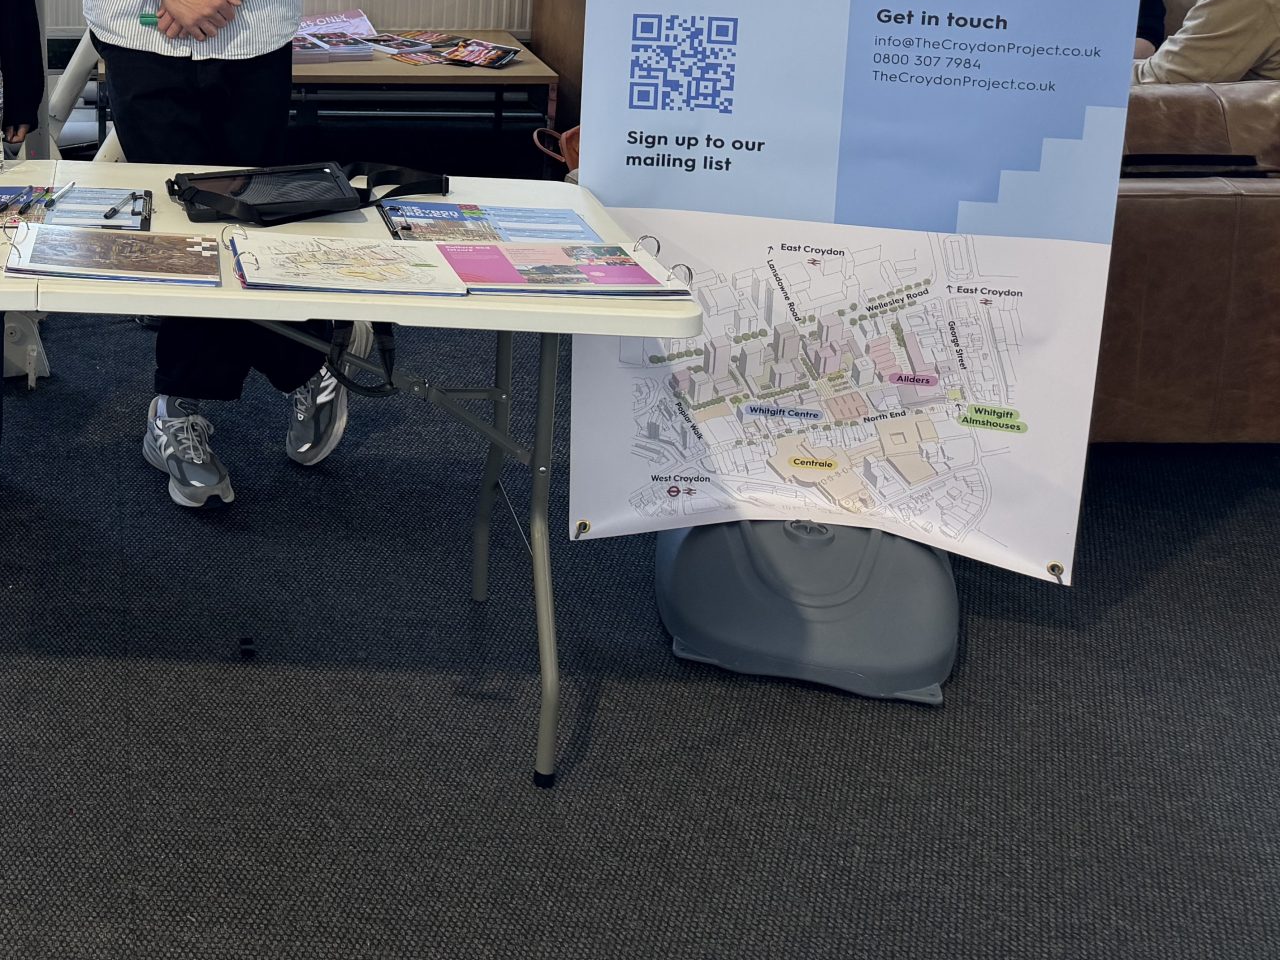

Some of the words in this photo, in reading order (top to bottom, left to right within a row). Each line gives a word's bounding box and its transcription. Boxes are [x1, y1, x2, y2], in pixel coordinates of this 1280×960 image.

[316, 13, 347, 26] ONLY
[877, 9, 914, 24] Get
[922, 11, 939, 26] in
[947, 13, 1007, 29] touch
[874, 35, 1101, 59] info@TheCroydonProject.co.uk
[874, 53, 909, 65] 0800
[914, 56, 941, 66] 307
[946, 57, 980, 69] 7984
[873, 71, 1055, 91] TheCroydonProject.co.uk
[627, 131, 667, 148] Sign
[676, 136, 698, 149] up
[706, 135, 724, 148] to
[732, 140, 765, 151] our
[626, 154, 695, 172] mailing
[704, 156, 731, 171] list
[781, 243, 802, 253] East
[804, 244, 845, 258] Croydon
[766, 259, 791, 300] Lansdowne
[786, 299, 802, 322] Road
[957, 285, 977, 295] East
[979, 286, 1023, 298] Croydon
[866, 295, 902, 312] Wellesley
[902, 288, 929, 301] Road
[948, 320, 961, 347] George
[953, 345, 967, 371] Street
[897, 374, 930, 385] Allders
[749, 406, 782, 418] Whitgift
[785, 408, 819, 419] Centre
[863, 413, 887, 423] North
[889, 410, 906, 420] End
[974, 407, 1013, 419] Whitgift
[674, 401, 693, 423] Poplar
[688, 422, 704, 441] Walk
[962, 416, 1021, 430] Almshouses
[793, 458, 833, 468] Centrale
[651, 474, 671, 483] West
[674, 474, 710, 484] Croydon
